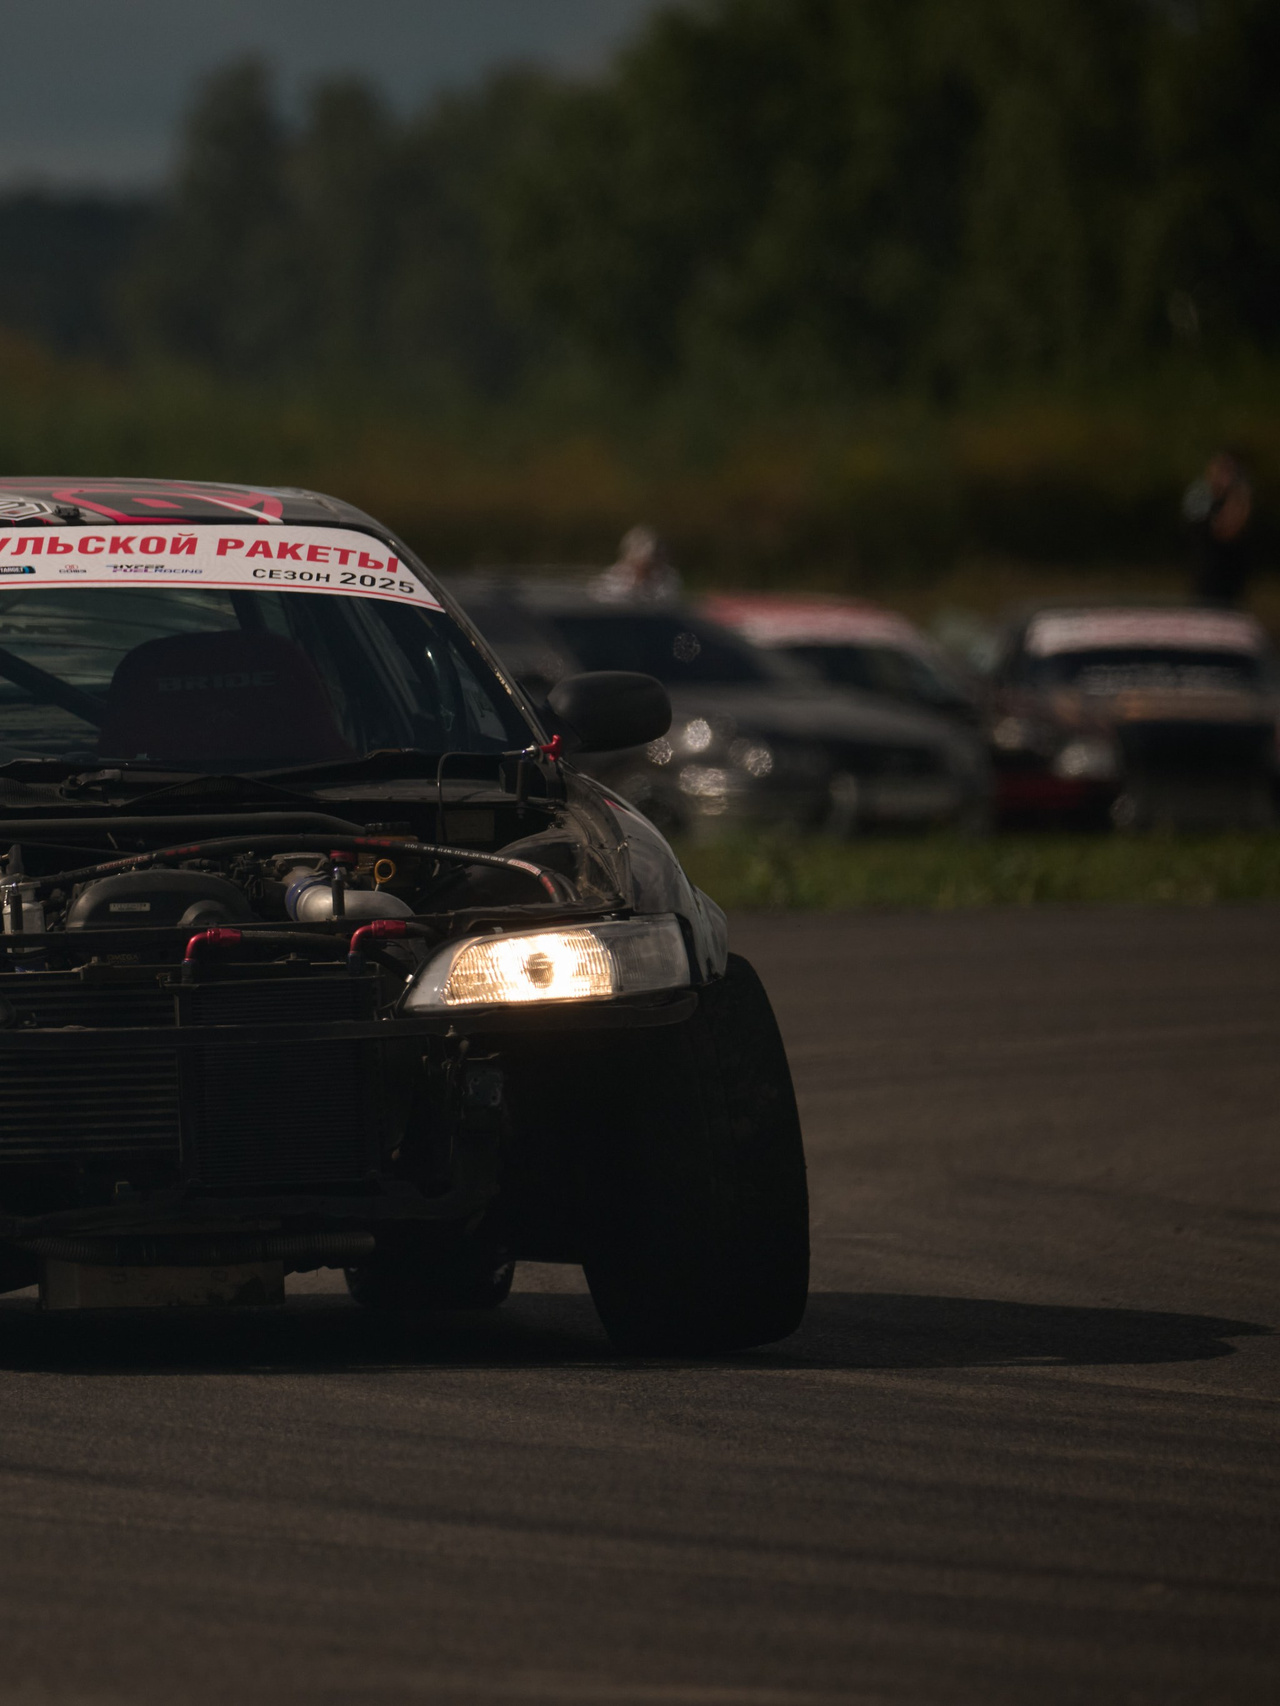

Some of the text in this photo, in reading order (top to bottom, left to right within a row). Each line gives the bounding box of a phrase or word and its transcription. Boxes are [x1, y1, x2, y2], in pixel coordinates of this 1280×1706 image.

[216, 537, 399, 573] РАКЕТЫ
[252, 568, 415, 595] СЕЗОН 2025
[157, 670, 279, 693] BRIDE
